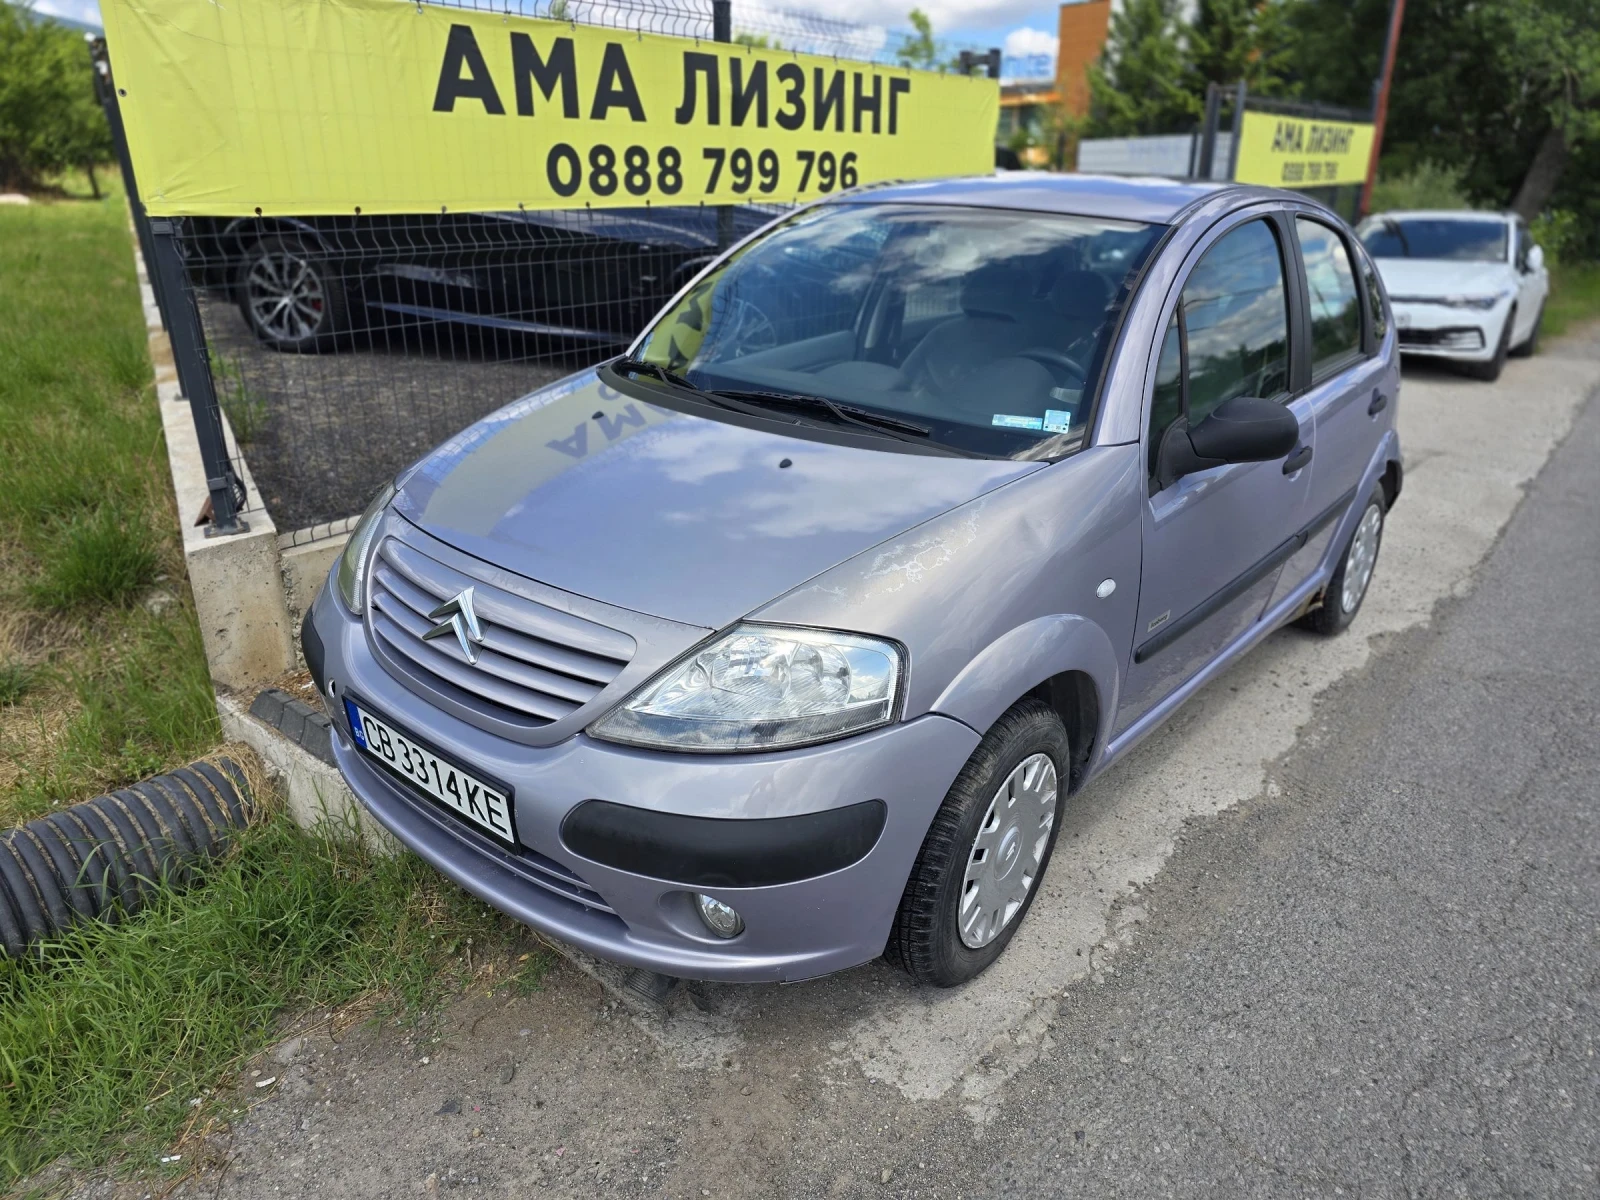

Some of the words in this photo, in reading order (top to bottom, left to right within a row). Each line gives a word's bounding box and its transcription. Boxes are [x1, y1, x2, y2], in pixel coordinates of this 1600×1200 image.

[433, 23, 647, 121] АМА
[675, 51, 911, 135] ЛИЗИНГ
[546, 143, 683, 197] 0888
[702, 147, 780, 194] 799
[796, 150, 858, 193] 796
